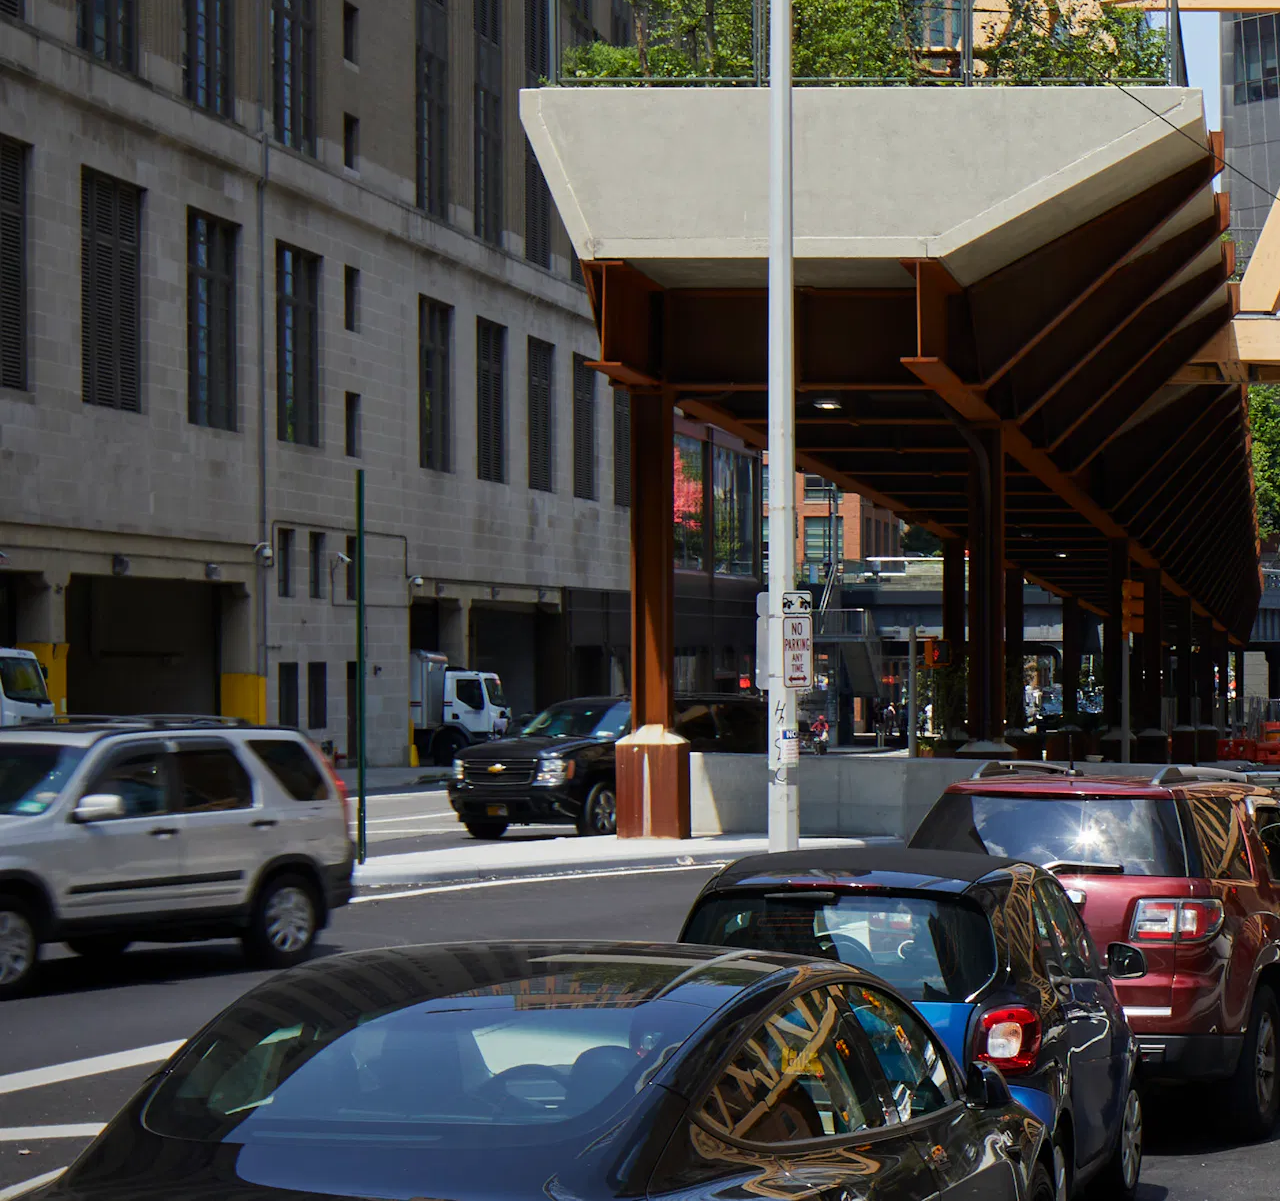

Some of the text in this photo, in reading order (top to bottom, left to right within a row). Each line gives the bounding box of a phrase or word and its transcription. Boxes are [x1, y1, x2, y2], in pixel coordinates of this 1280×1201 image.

[791, 622, 803, 636] NO
[784, 638, 811, 652] PARKING
[792, 653, 804, 662] ANY
[791, 663, 805, 673] TIME
